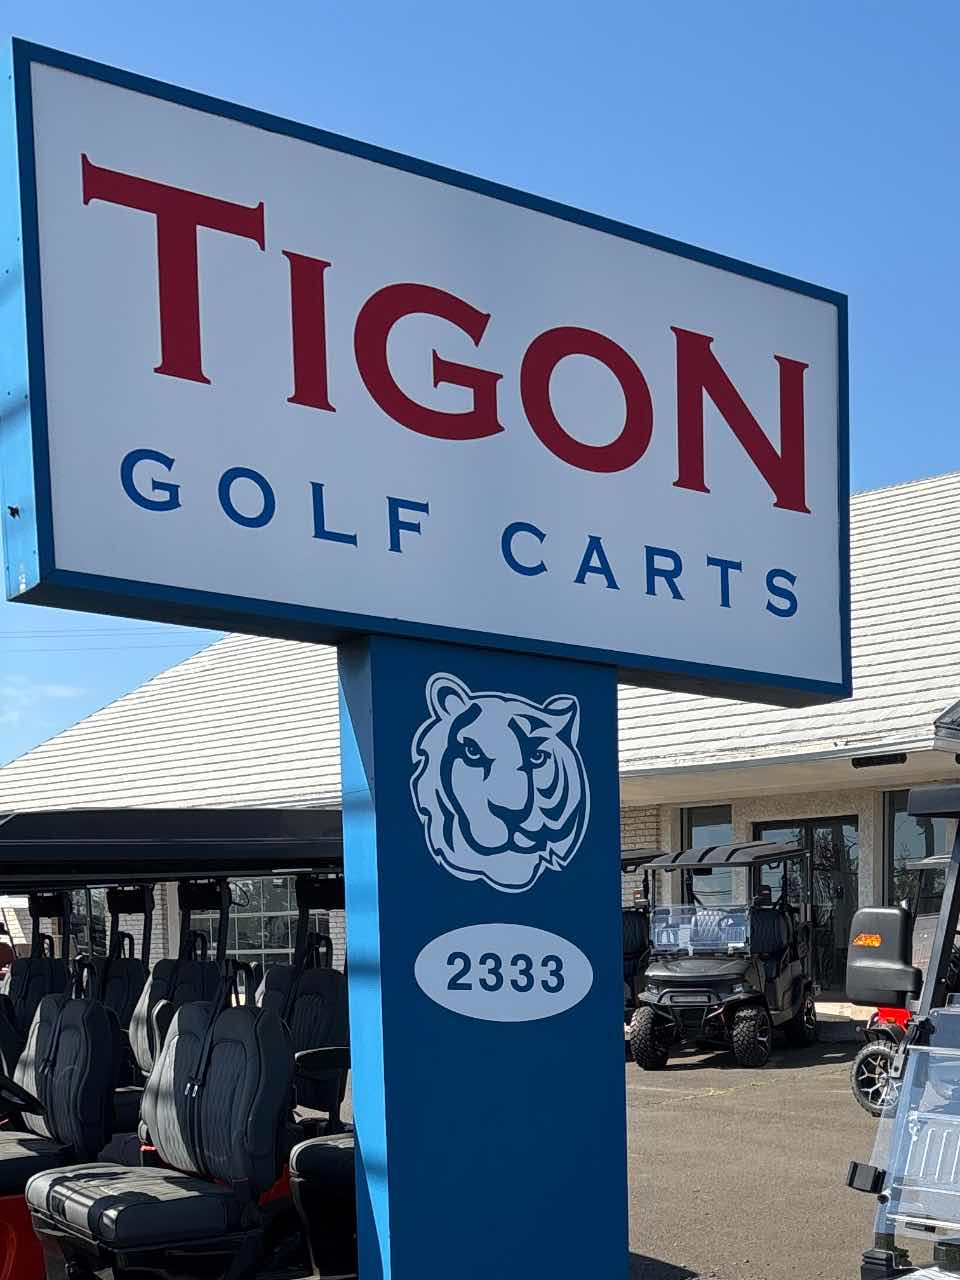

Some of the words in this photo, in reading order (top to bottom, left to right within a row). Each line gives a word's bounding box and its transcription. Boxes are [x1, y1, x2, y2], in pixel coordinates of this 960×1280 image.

[80, 152, 812, 515] TIGON
[120, 447, 430, 554] GOLF
[500, 521, 799, 619] CARTS
[446, 951, 566, 994] 2333
